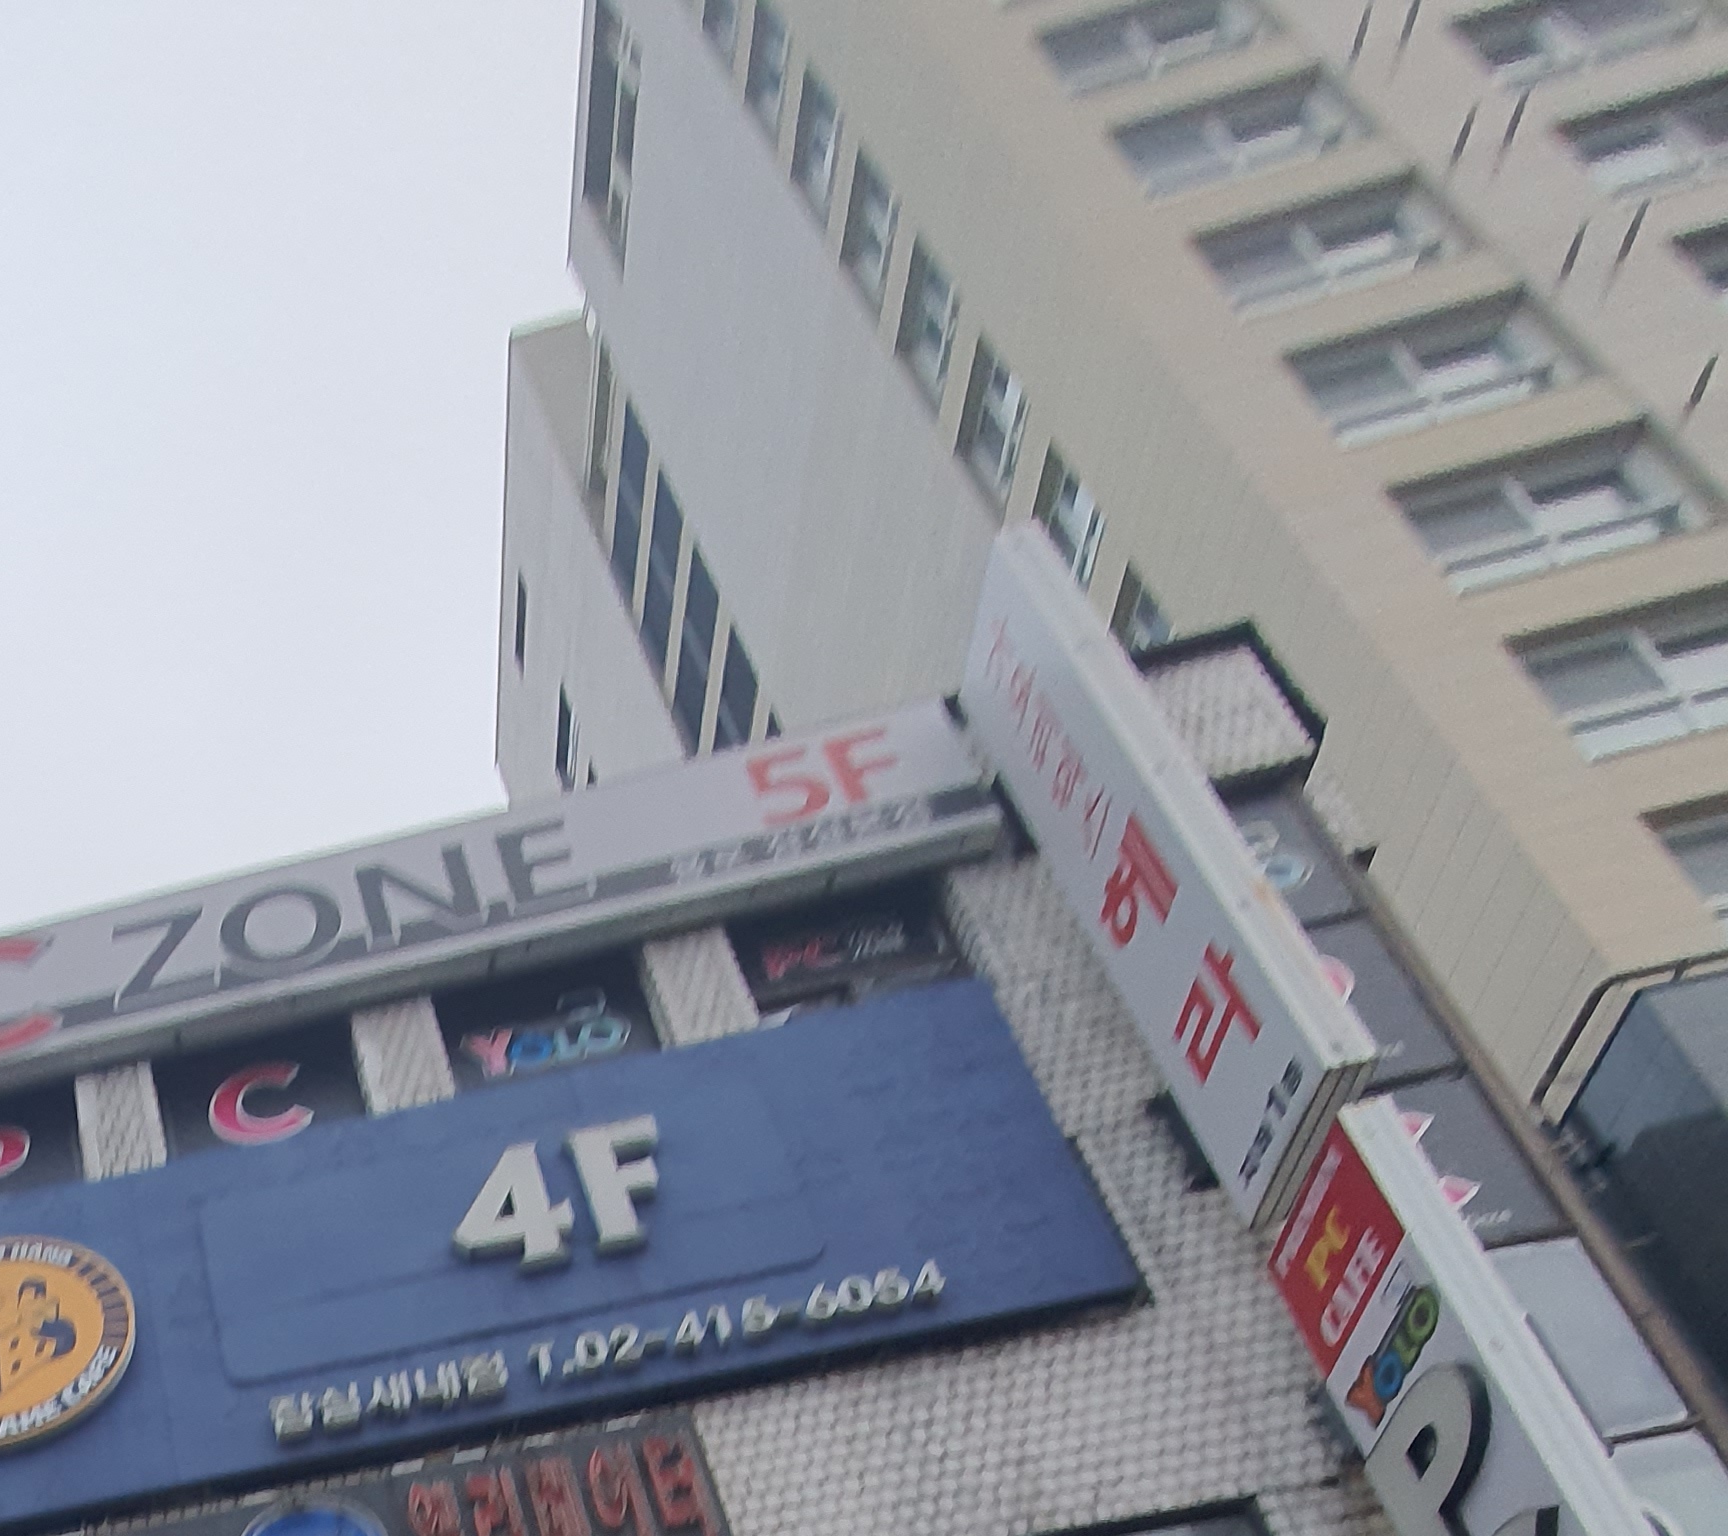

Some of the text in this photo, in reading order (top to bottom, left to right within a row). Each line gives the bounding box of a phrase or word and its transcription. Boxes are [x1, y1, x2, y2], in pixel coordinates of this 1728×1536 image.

[112, 815, 577, 1011] ZONE
[746, 725, 898, 827] 5F
[452, 1114, 660, 1270] 4F
